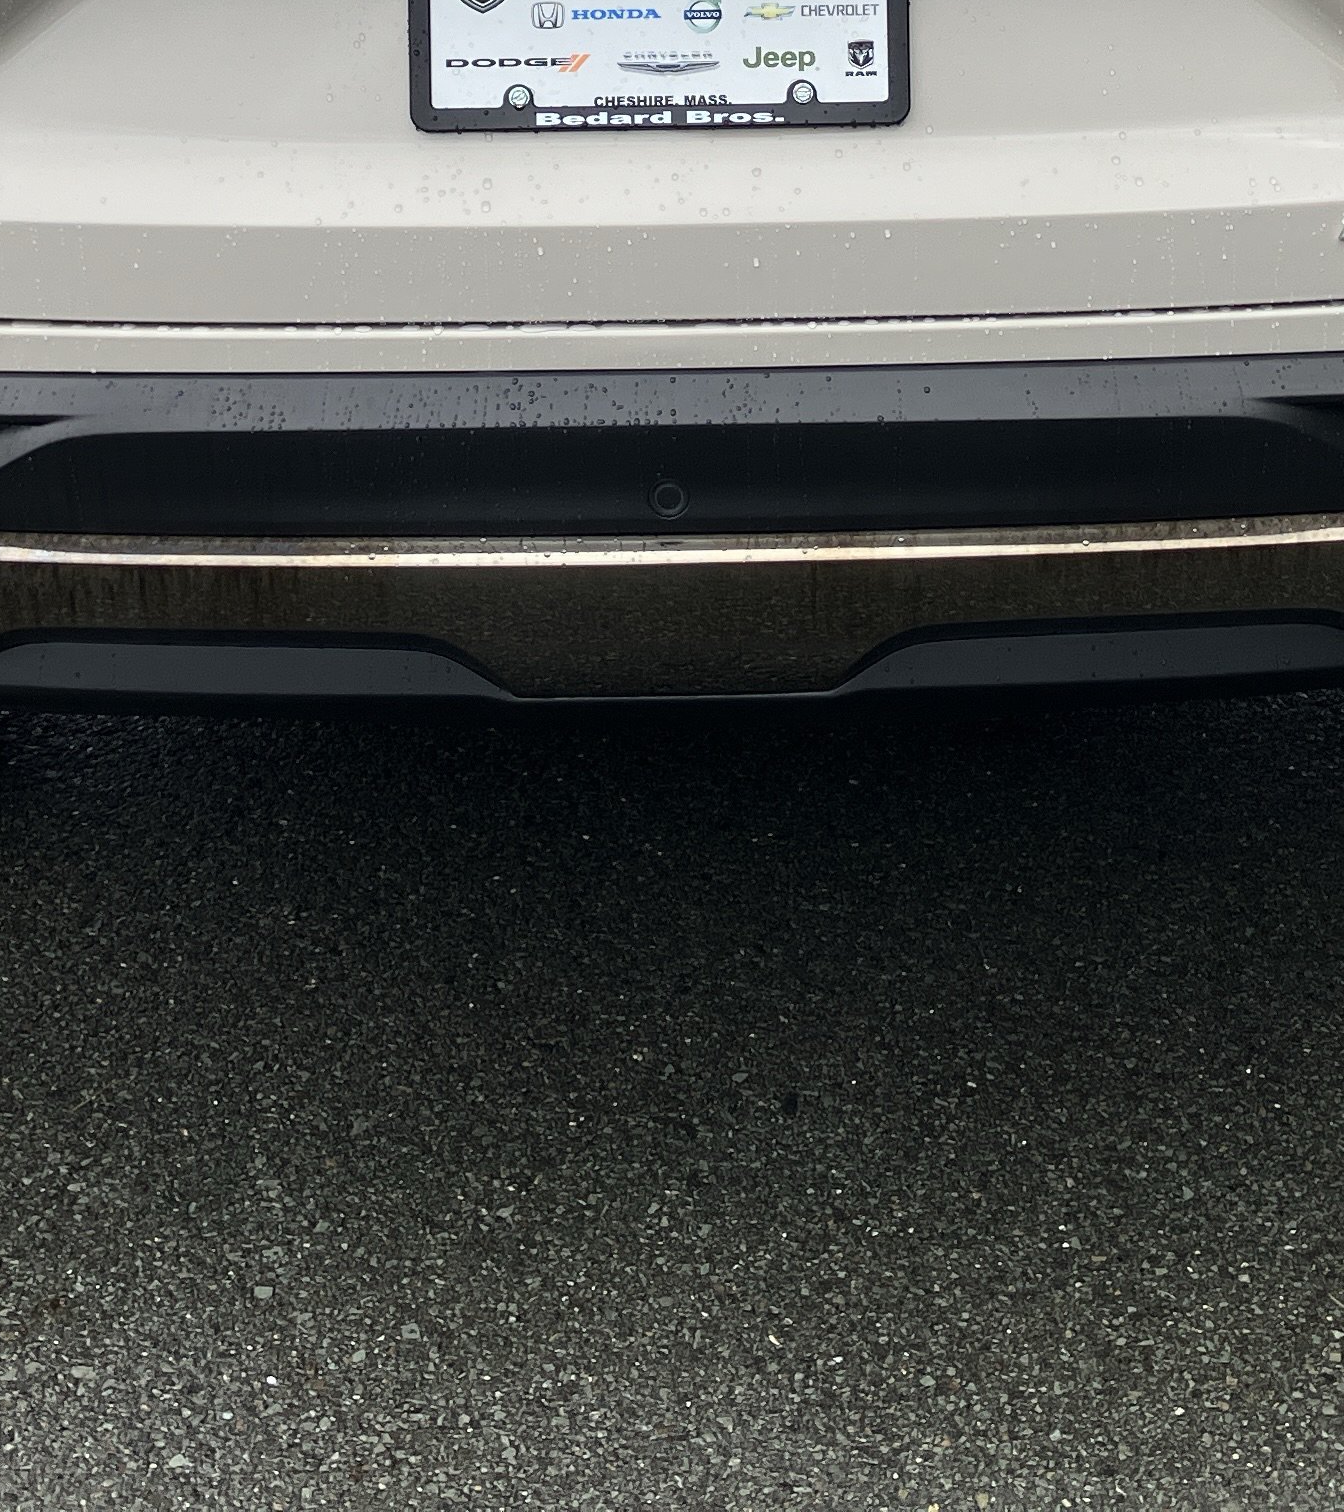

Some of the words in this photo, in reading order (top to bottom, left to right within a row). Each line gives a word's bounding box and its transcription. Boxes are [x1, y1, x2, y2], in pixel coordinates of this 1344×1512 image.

[571, 8, 662, 21] HONDA
[686, 10, 720, 18] VOLVO
[800, 3, 880, 18] CHEVROLET
[445, 57, 574, 68] DODGE
[742, 46, 817, 72] Jeep
[684, 94, 733, 106] MASS.
[535, 110, 673, 126] Bedard
[686, 109, 785, 124] Bros.
